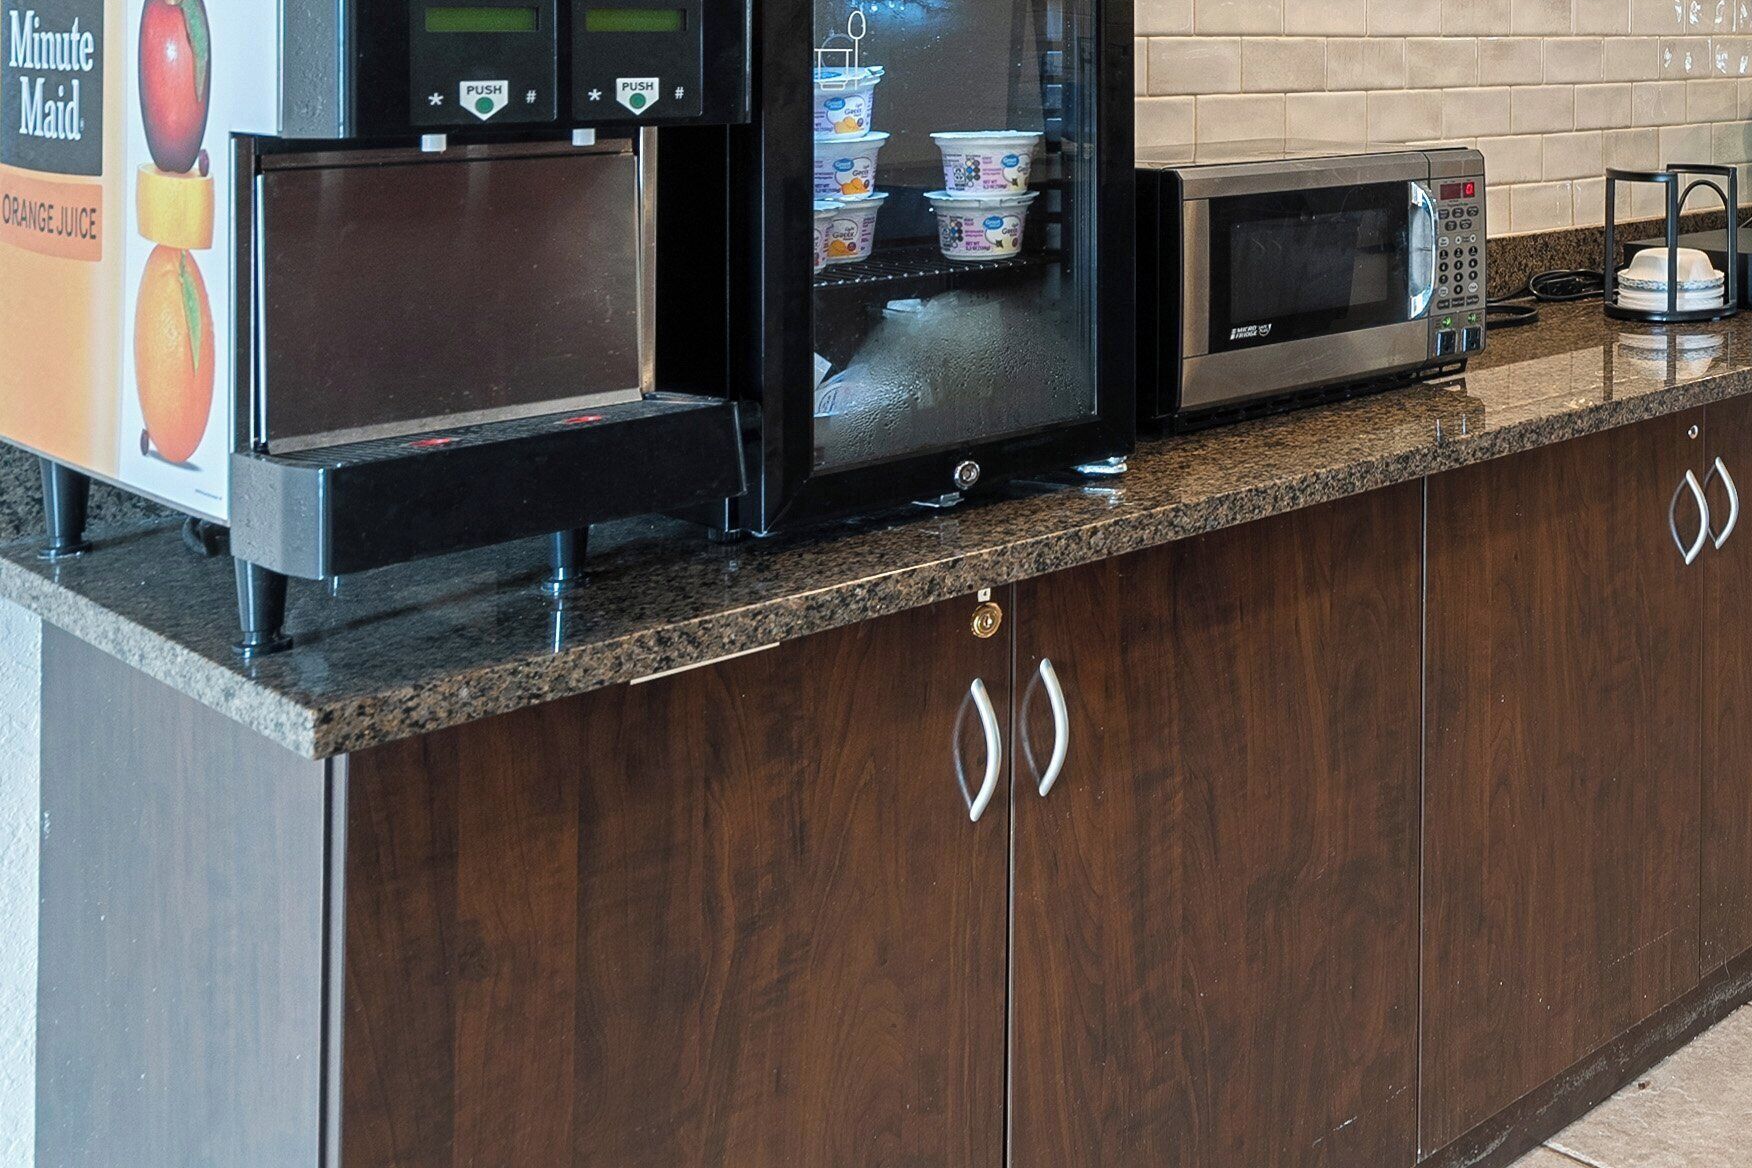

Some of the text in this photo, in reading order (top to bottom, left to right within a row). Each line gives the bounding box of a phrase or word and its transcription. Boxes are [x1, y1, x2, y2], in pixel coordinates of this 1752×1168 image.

[9, 10, 94, 72] Minute
[19, 76, 82, 141] Maid
[466, 85, 502, 95] PUSH
[622, 81, 654, 91] PUSH
[2, 193, 97, 240] ORANGE JUICE
